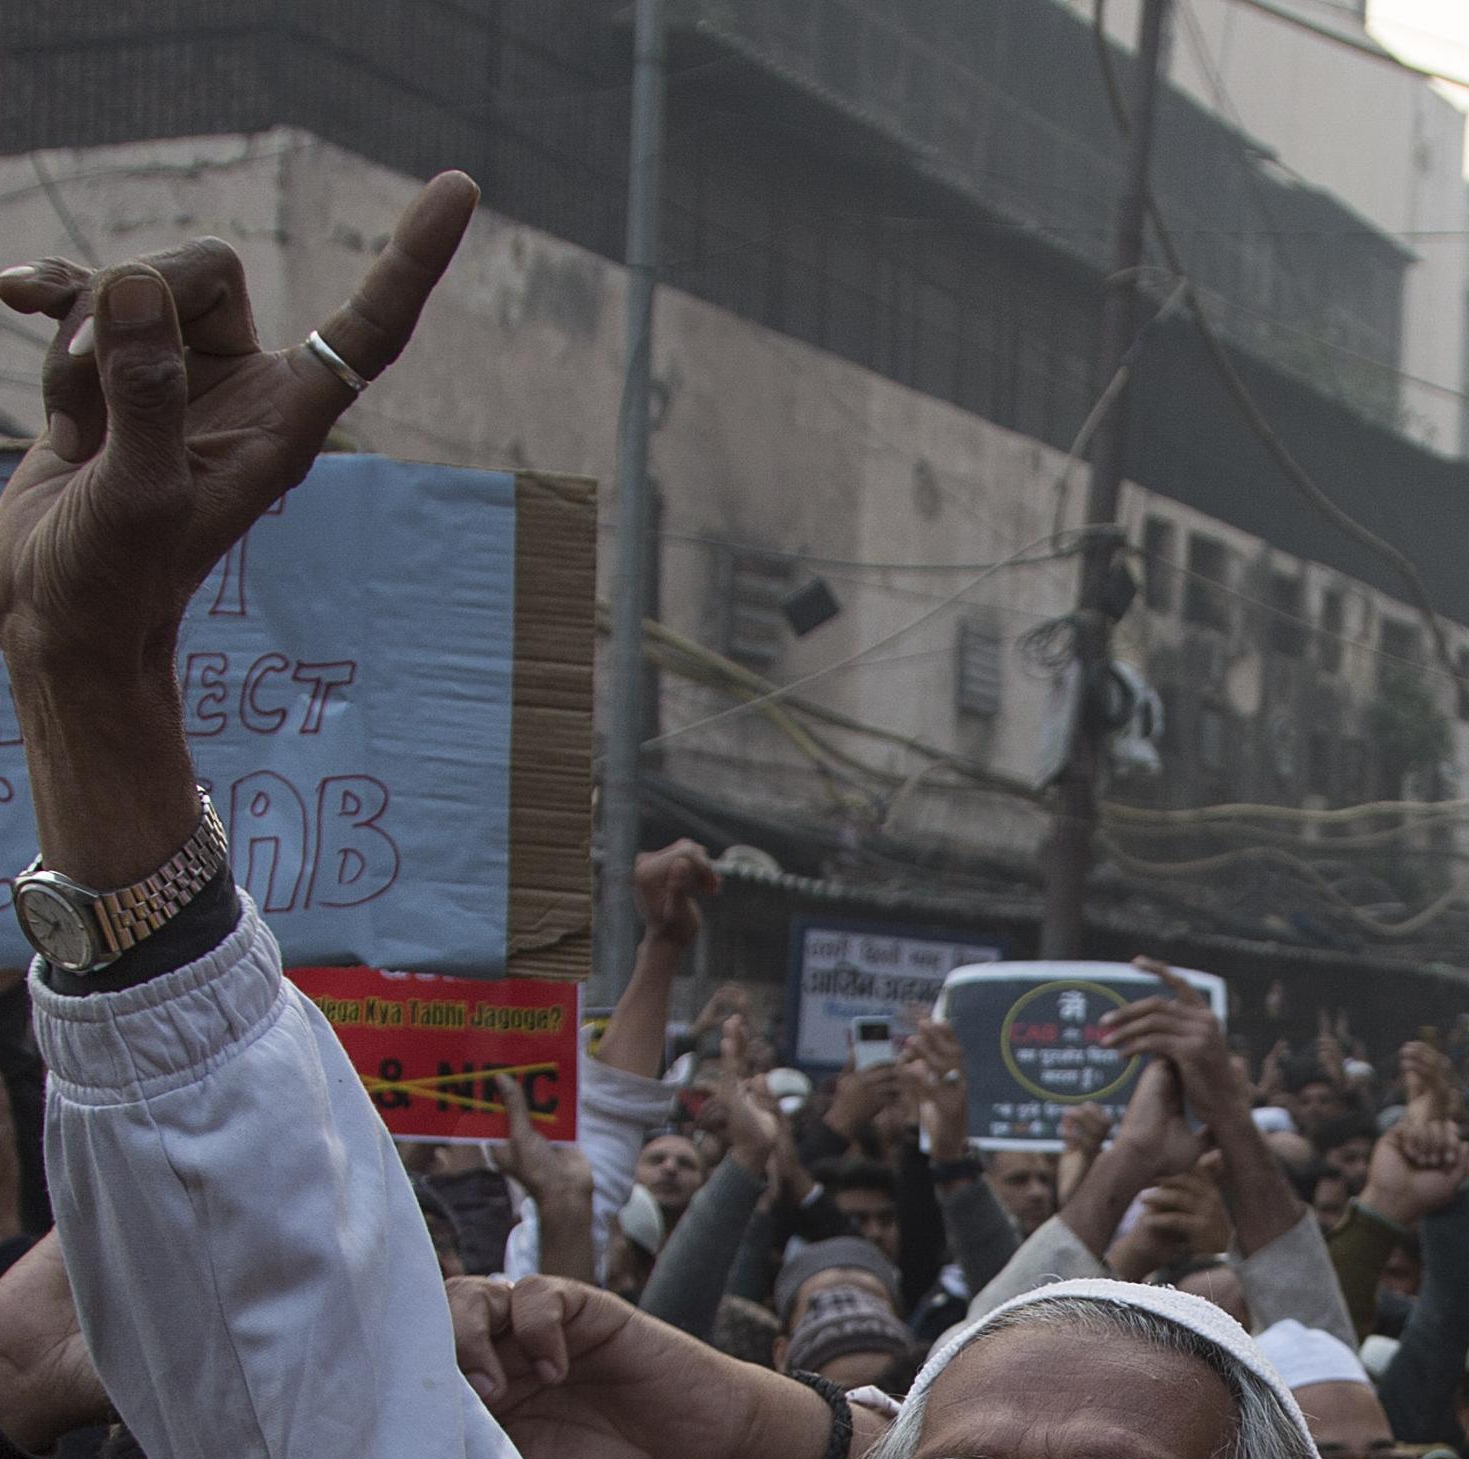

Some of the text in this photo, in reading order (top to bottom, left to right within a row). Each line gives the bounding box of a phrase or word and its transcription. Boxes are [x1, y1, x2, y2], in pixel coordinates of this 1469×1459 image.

[196, 769, 402, 914] AB
[364, 996, 404, 1028] Kya
[408, 998, 466, 1029] Tabhi
[470, 1002, 564, 1034] Jagoge?
[377, 1057, 411, 1110] &
